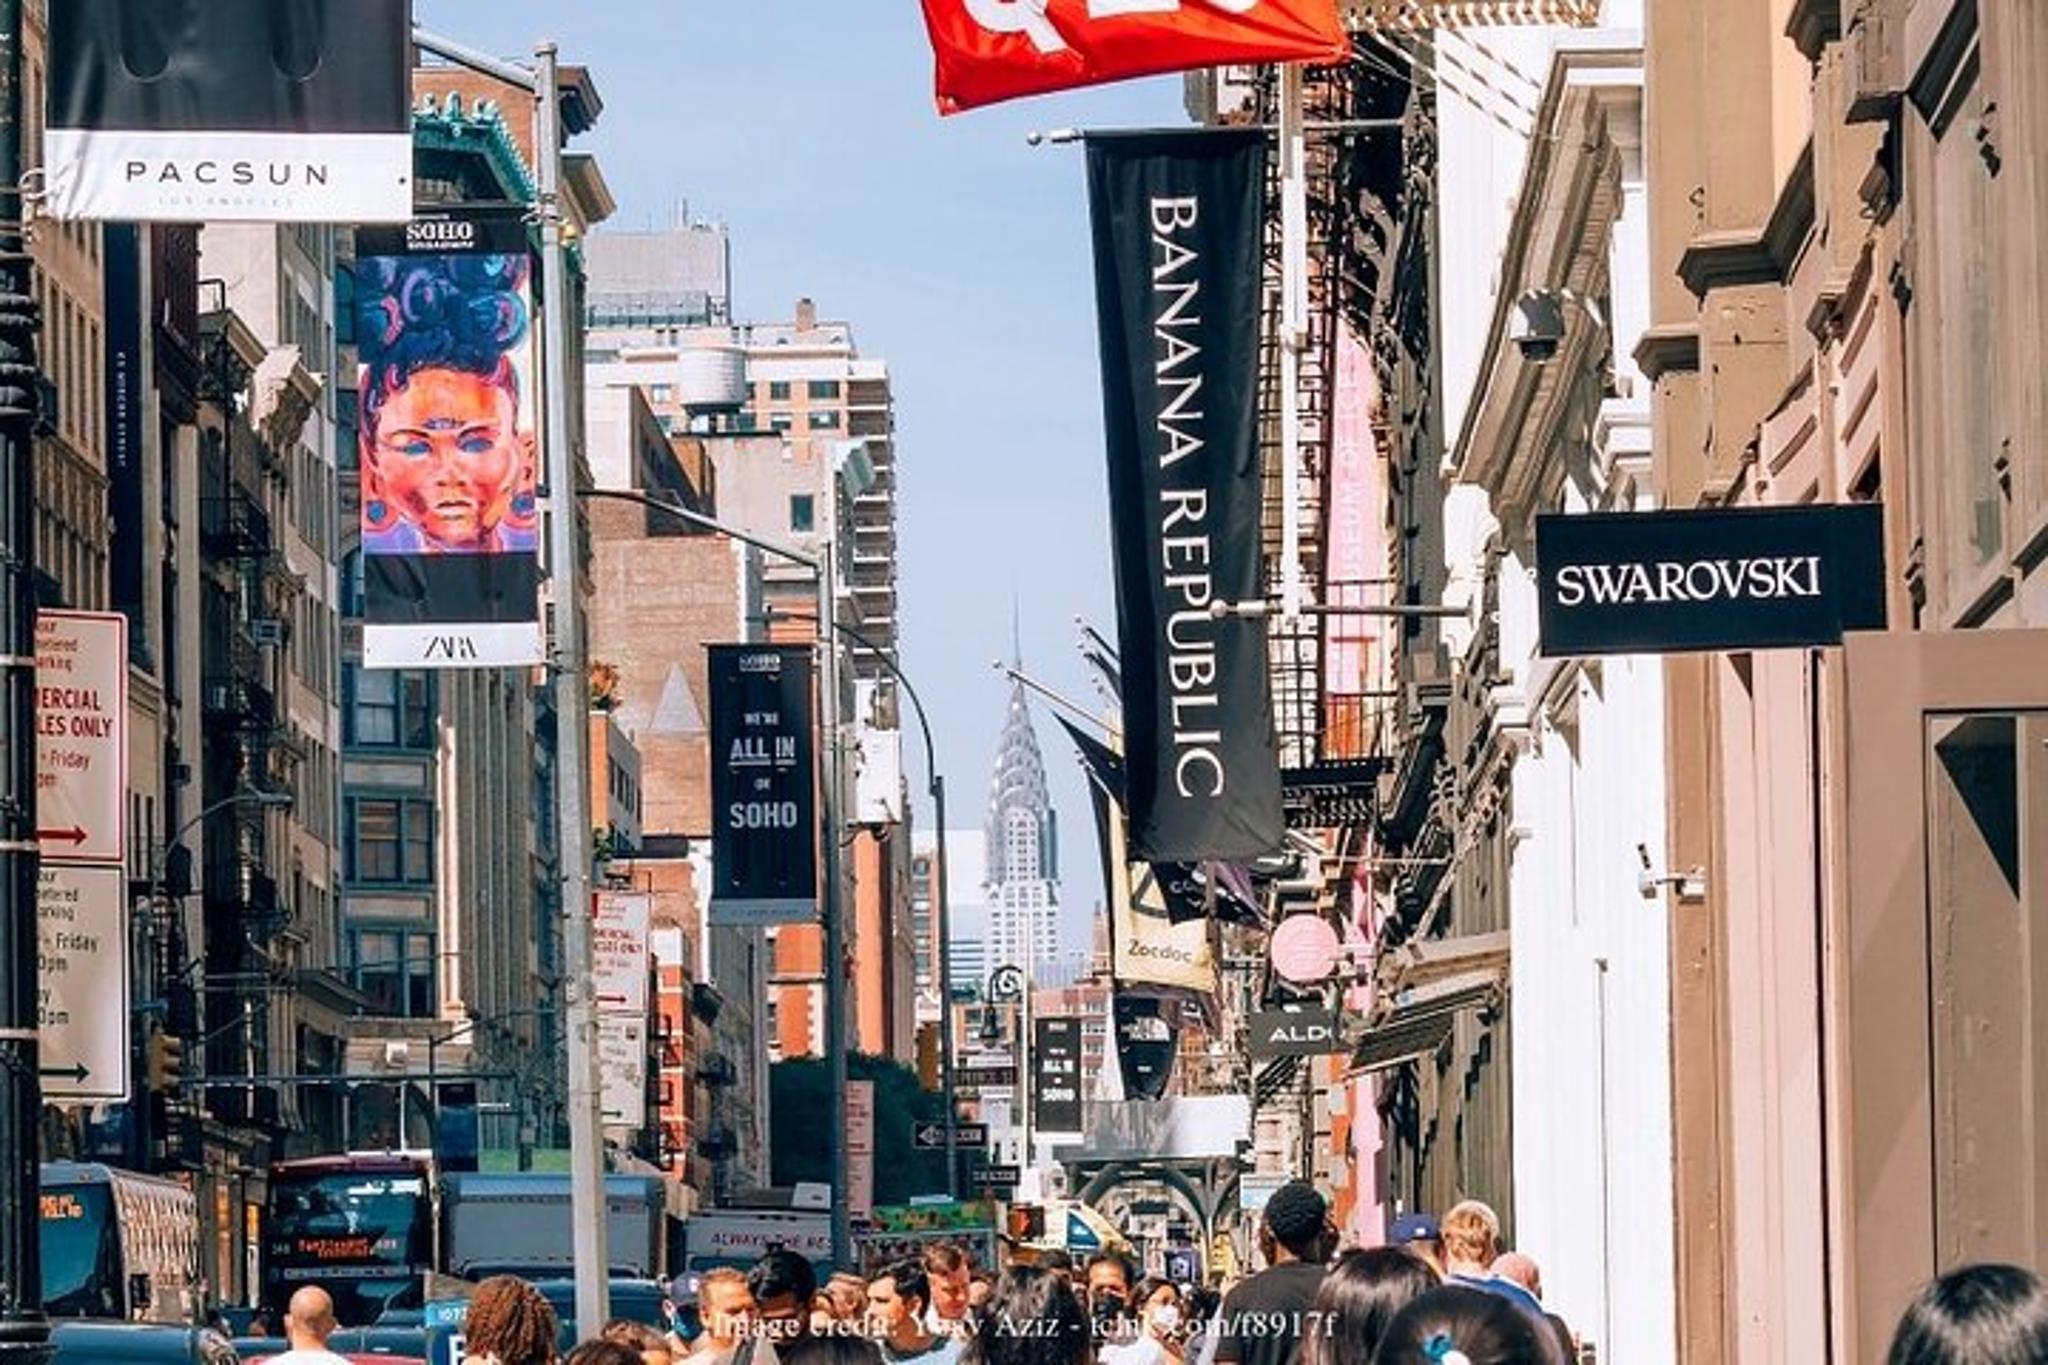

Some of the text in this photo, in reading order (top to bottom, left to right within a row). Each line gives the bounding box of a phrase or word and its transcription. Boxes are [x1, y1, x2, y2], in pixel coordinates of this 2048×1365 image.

[126, 161, 328, 186] PACSUN
[406, 221, 474, 239] SOHO
[1151, 196, 1205, 470] BANANA
[1556, 556, 1822, 606] SWAROVSKI
[423, 635, 477, 659] ZARA
[1160, 488, 1225, 798] REPUBLIC
[36, 686, 101, 711] ERCIAL
[38, 715, 112, 737] LES ONLY
[729, 736, 796, 760] ALL IN
[51, 749, 90, 771] Friday
[729, 801, 798, 829] SOHO
[37, 871, 56, 882] our
[36, 888, 79, 902] etered
[37, 906, 74, 922] arking
[56, 932, 98, 953] Friday
[1128, 939, 1193, 963] Zocdoc
[38, 955, 68, 974] 0pm
[38, 1006, 69, 1025] 0pm
[711, 1232, 766, 1247] ALWAYS
